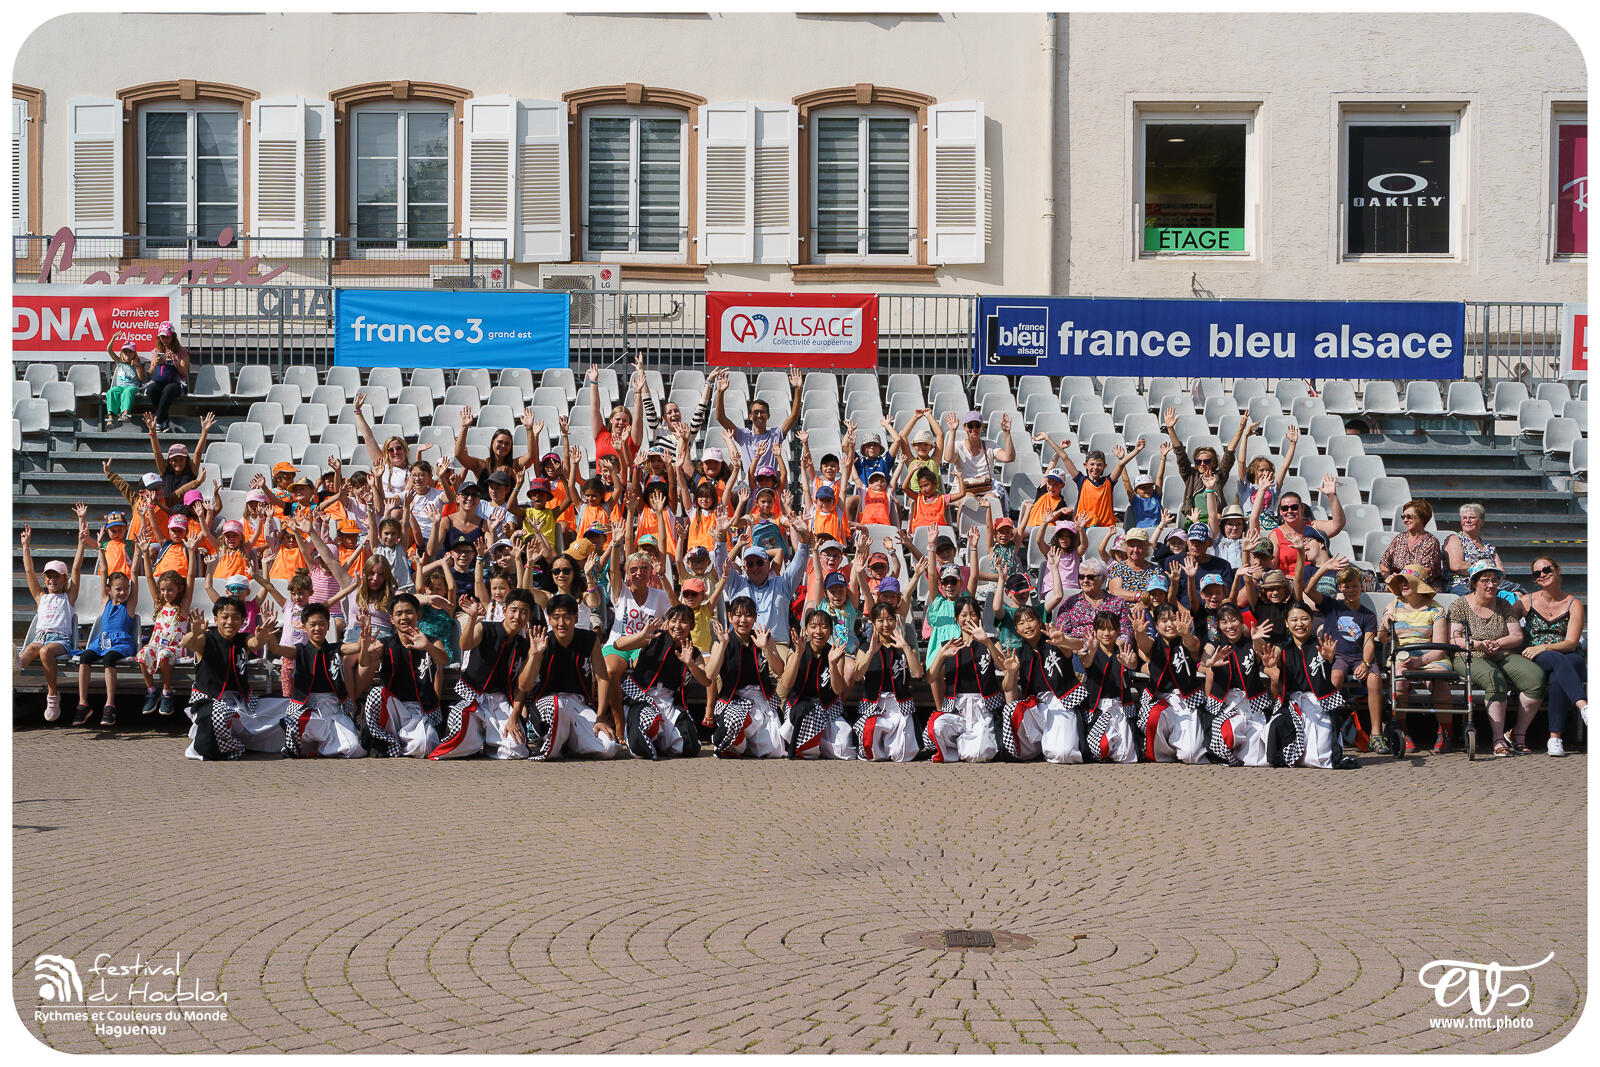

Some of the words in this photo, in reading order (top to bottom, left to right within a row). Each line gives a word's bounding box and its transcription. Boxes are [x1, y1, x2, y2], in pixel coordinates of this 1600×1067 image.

[1353, 197, 1443, 207] OAKLEY
[1159, 228, 1230, 249] ÉTAGE
[112, 308, 160, 318] Dernières
[12, 307, 104, 341] DNA
[112, 321, 160, 329] Nouvelles
[773, 316, 853, 337] ALSACE
[1018, 322, 1045, 332] france
[114, 331, 153, 341] Alsace
[488, 329, 515, 340] grand
[999, 326, 1045, 347] bleu
[772, 337, 811, 346] Collectivité
[812, 338, 853, 347] européenne
[1057, 321, 1191, 357] france
[1209, 323, 1296, 358] bleu
[1313, 324, 1452, 359] alsace
[1017, 346, 1045, 355] alsace
